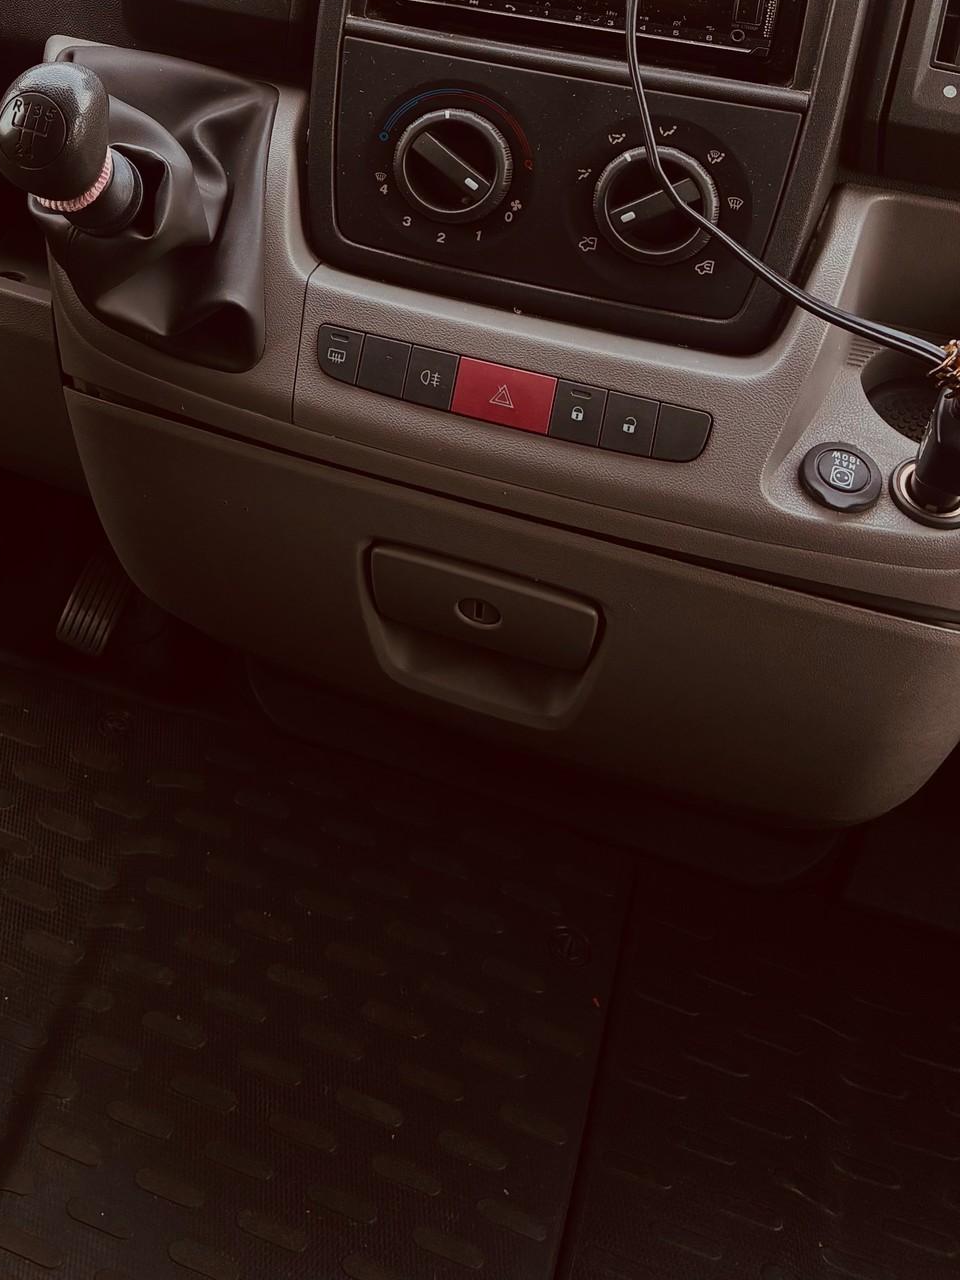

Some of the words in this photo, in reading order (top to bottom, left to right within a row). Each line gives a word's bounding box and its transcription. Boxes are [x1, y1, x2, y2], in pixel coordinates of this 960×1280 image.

[12, 98, 23, 112] R
[44, 107, 57, 122] 5
[379, 184, 388, 195] 4
[402, 216, 412, 227] 3
[504, 211, 514, 222] 0
[436, 232, 446, 243] 2
[475, 231, 482, 241] 1
[832, 451, 860, 465] 180W
[834, 458, 856, 470] MAX
